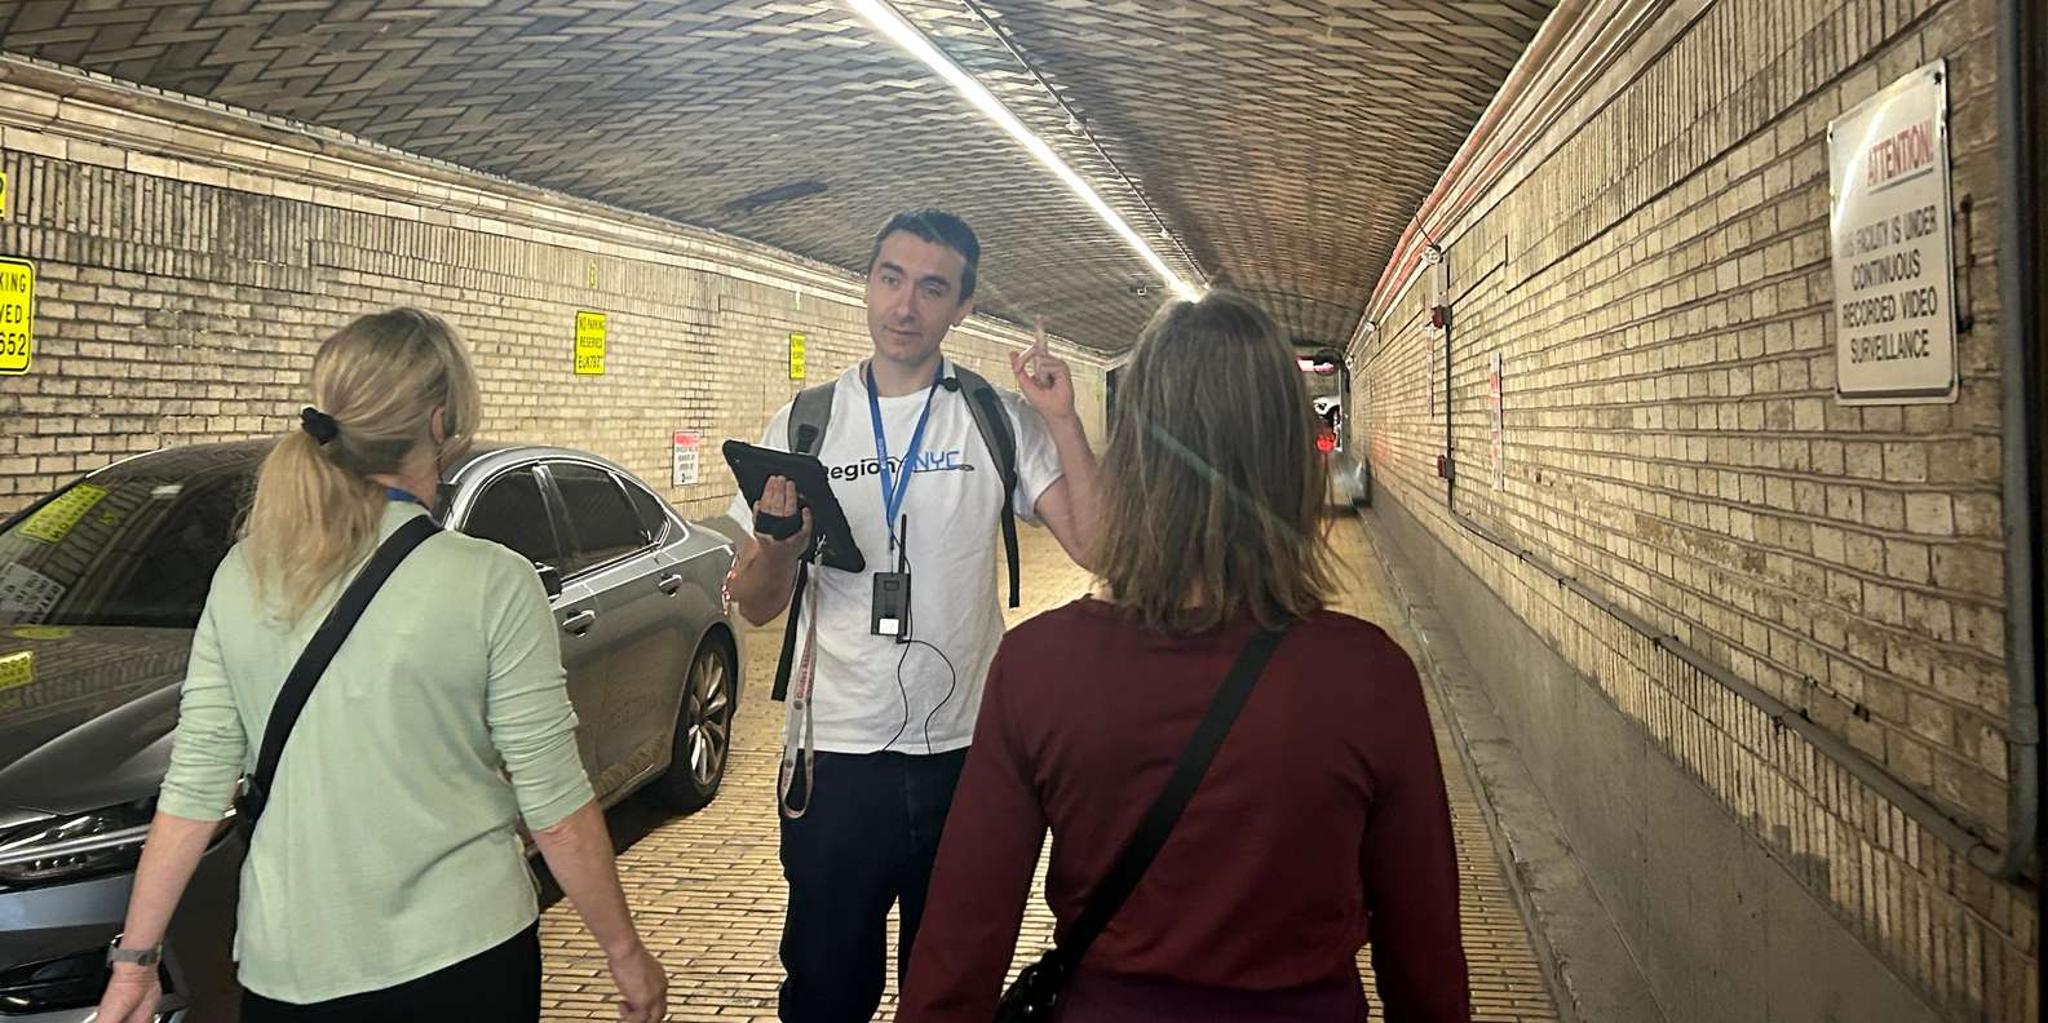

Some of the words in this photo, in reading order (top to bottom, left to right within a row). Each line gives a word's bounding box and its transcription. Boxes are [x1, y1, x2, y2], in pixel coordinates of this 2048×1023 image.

[1867, 119, 1934, 187] ATTENTION!
[1892, 215, 1900, 245] IS
[1903, 205, 1937, 241] UNDER
[1851, 248, 1920, 291] CONTINUOUS
[1842, 294, 1896, 329] RECORDED
[1900, 285, 1938, 319] VIDEO
[1851, 328, 1930, 364] SURVEILLANCE
[825, 459, 896, 481] egion
[912, 450, 960, 470] NYC
